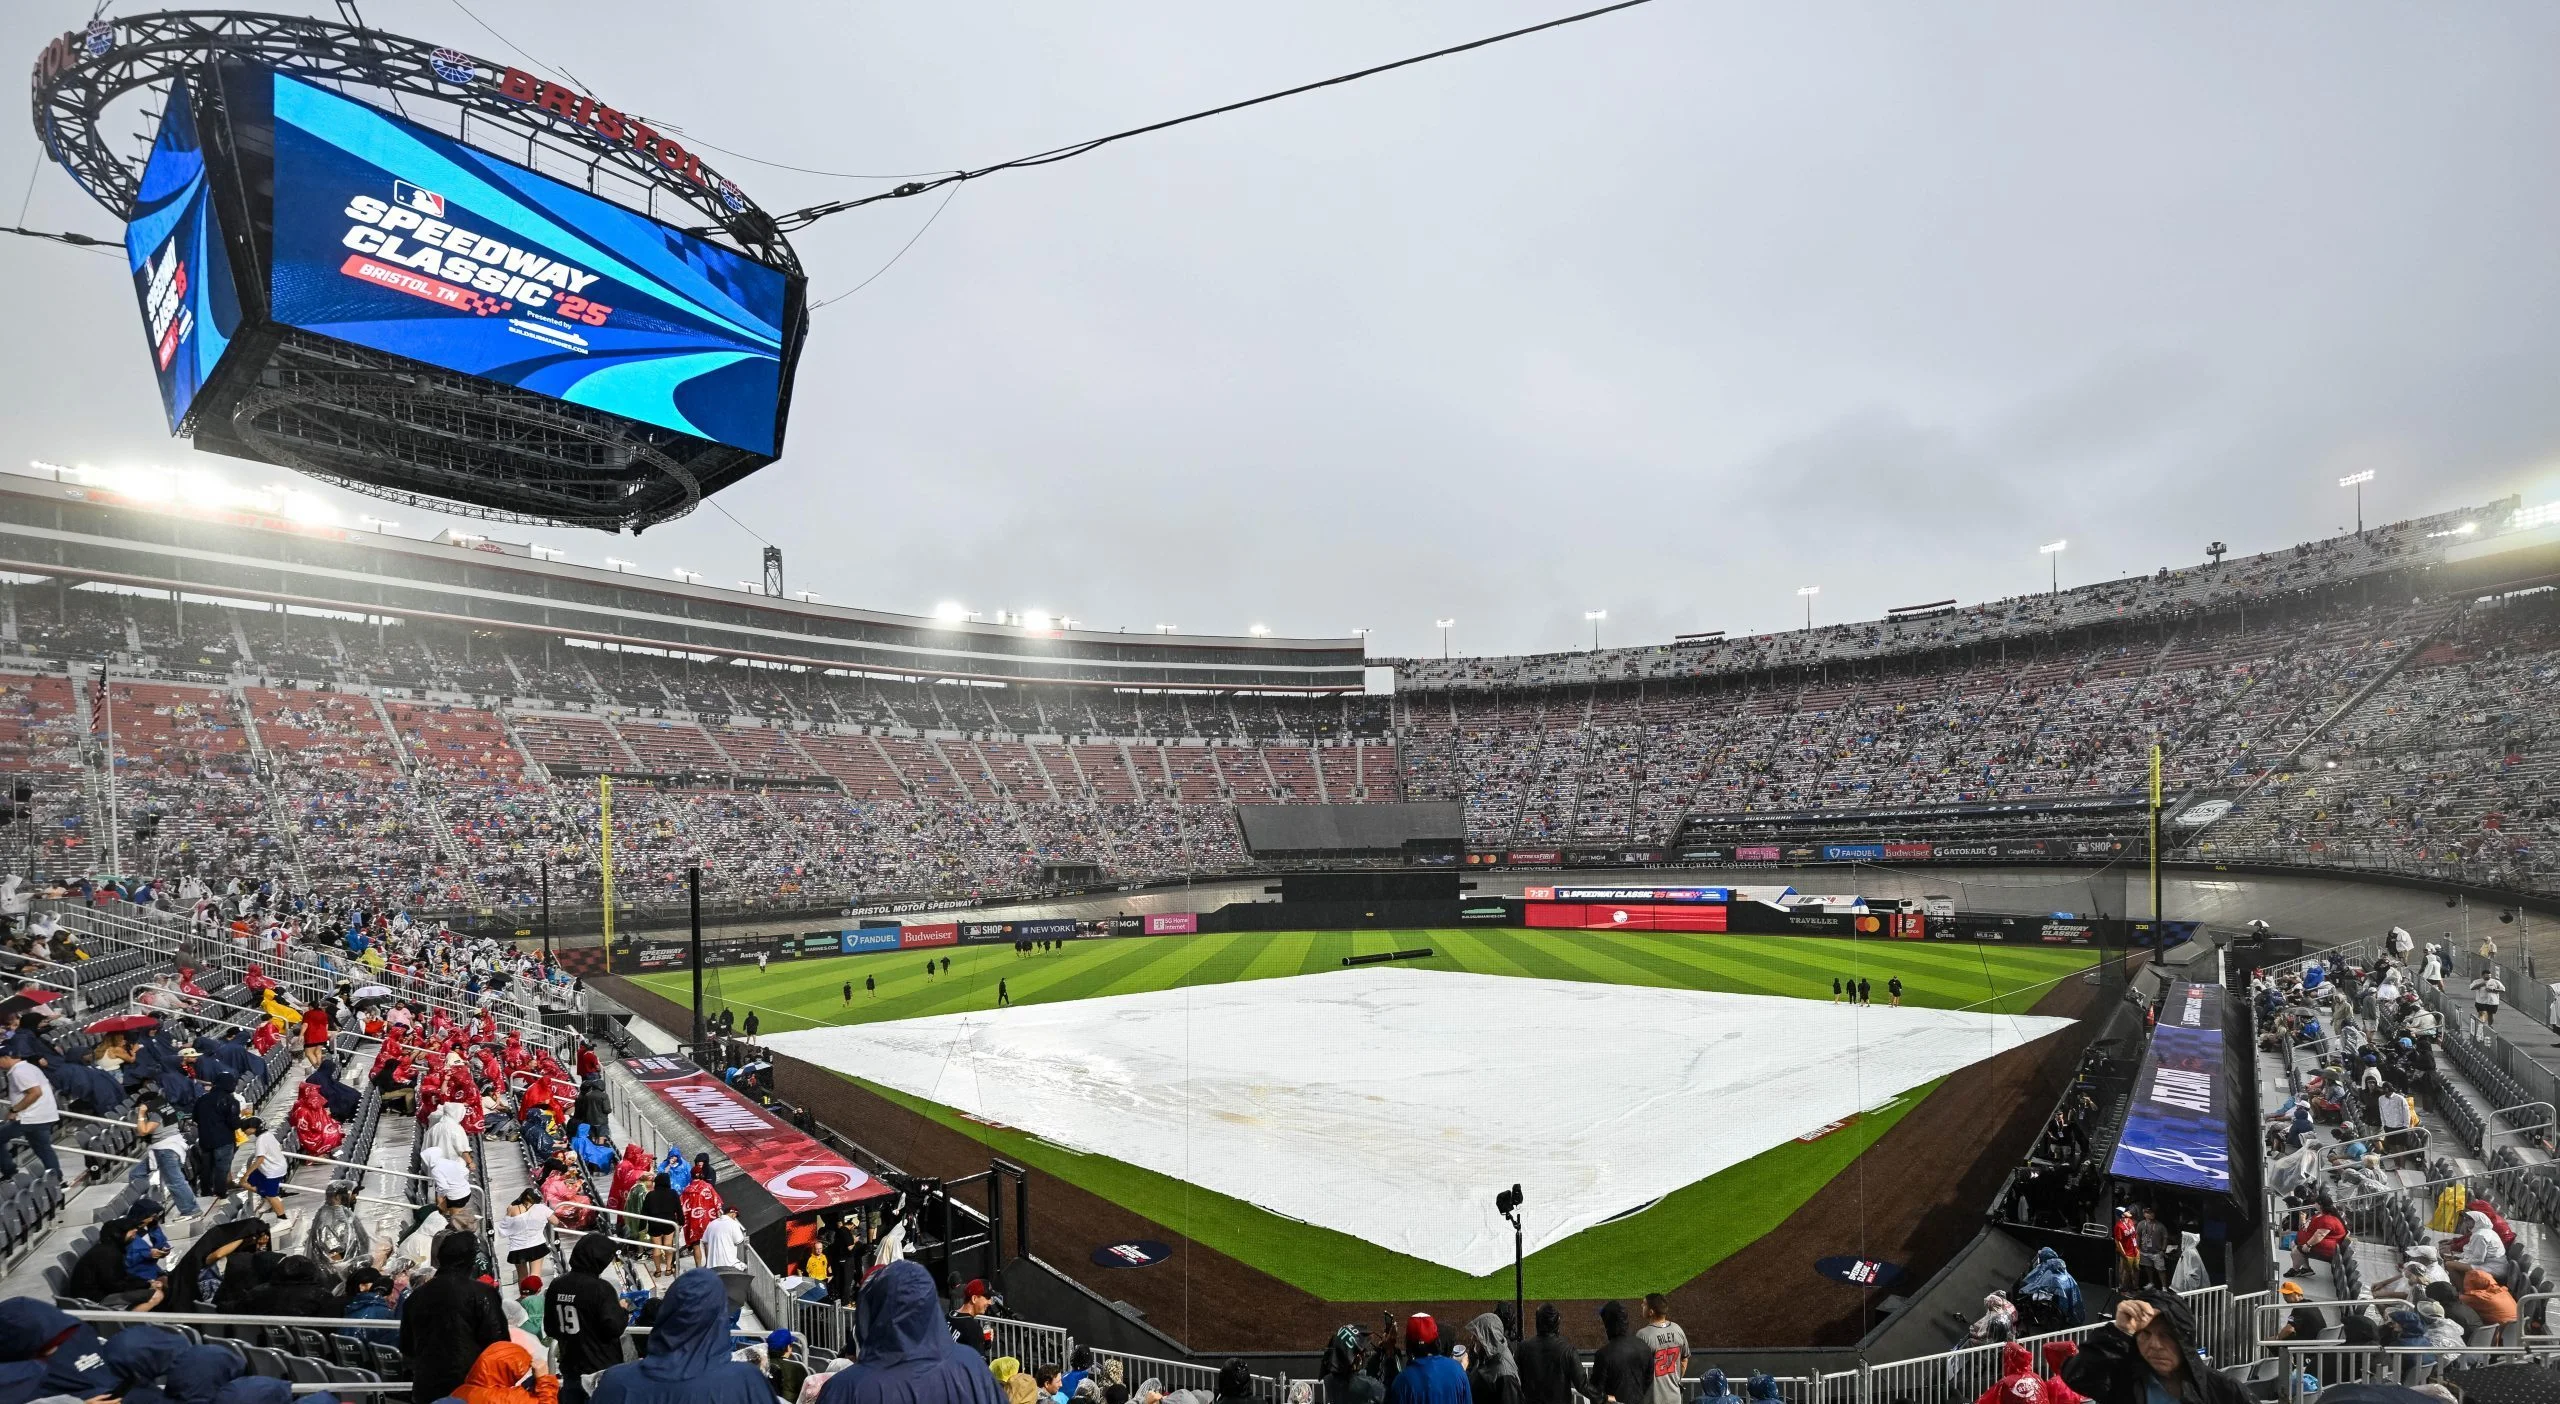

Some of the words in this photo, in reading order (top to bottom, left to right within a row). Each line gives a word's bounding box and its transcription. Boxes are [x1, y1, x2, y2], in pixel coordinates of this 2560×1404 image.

[500, 66, 706, 187] BRISTOL
[344, 195, 600, 294] SPEEDWAY
[342, 225, 554, 307] CLASSIC
[359, 263, 433, 297] BRISTOL,
[437, 285, 460, 302] TN
[527, 310, 562, 327] Presented
[561, 319, 572, 330] by
[1943, 848, 1987, 856] GATORADE
[2090, 842, 2111, 852] SHOP
[1885, 849, 1930, 857] Budweiser
[1529, 890, 1549, 898] 7:27
[1570, 890, 1616, 898] SPEEDWAY
[1614, 890, 1654, 898] CLASSIC
[852, 906, 890, 916] BRISTOL
[893, 903, 925, 912] MOTOR
[927, 900, 974, 910] SPEEDWAY
[1119, 920, 1139, 928] MGM
[1789, 917, 1838, 925] TRAVELLER
[982, 925, 1003, 935] SHOP
[1030, 926, 1048, 934] NEW
[1049, 925, 1069, 933] YORK
[859, 935, 896, 945] FANDUEL
[905, 930, 953, 943] Budweiser
[640, 947, 685, 956] SPEEDWAY
[640, 953, 676, 962] CLASSIC
[556, 1304, 581, 1335] 19
[1656, 1331, 1675, 1346] RILEY
[1654, 1345, 1681, 1378] 27
